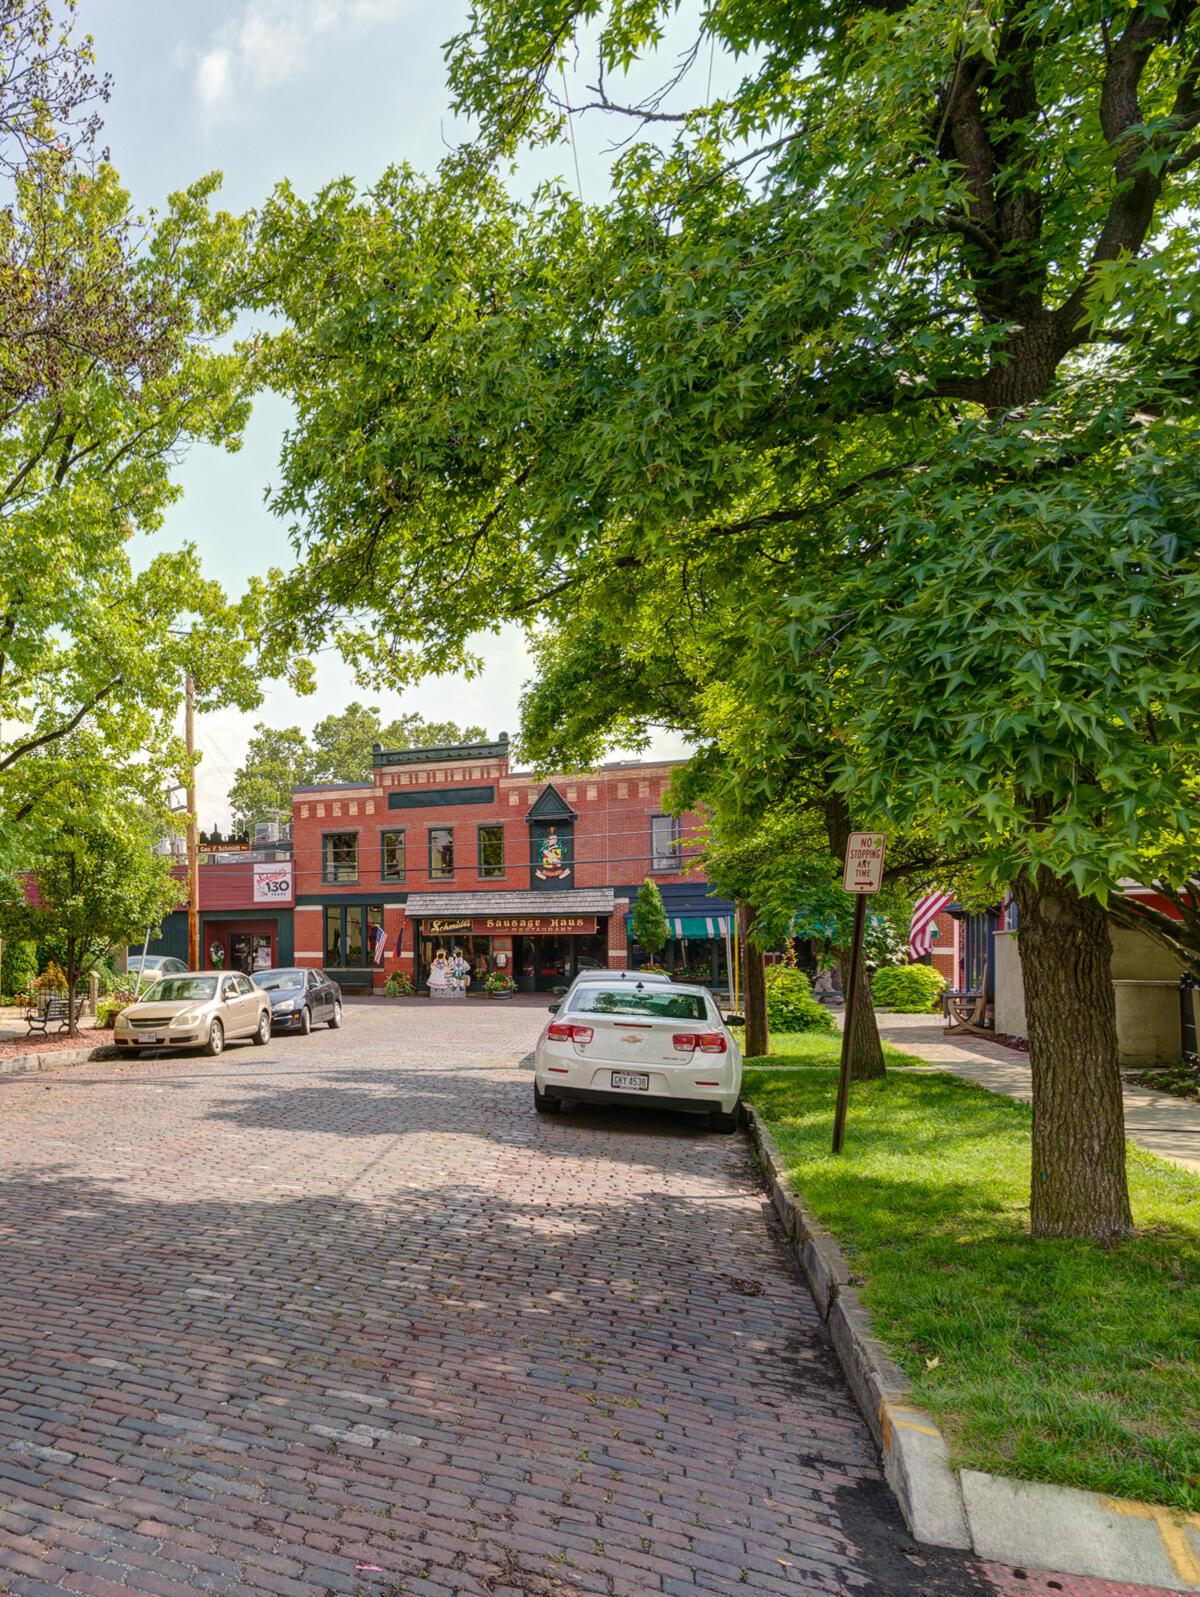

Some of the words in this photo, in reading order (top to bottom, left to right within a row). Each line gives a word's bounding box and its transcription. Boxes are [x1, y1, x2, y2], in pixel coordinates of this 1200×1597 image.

[860, 838, 872, 847] NO
[850, 849, 880, 859] STOPPING
[857, 860, 871, 868] ANY
[855, 869, 871, 877] TIME
[265, 880, 290, 893] 130
[486, 918, 541, 928] Sausage
[550, 918, 585, 928] Haus
